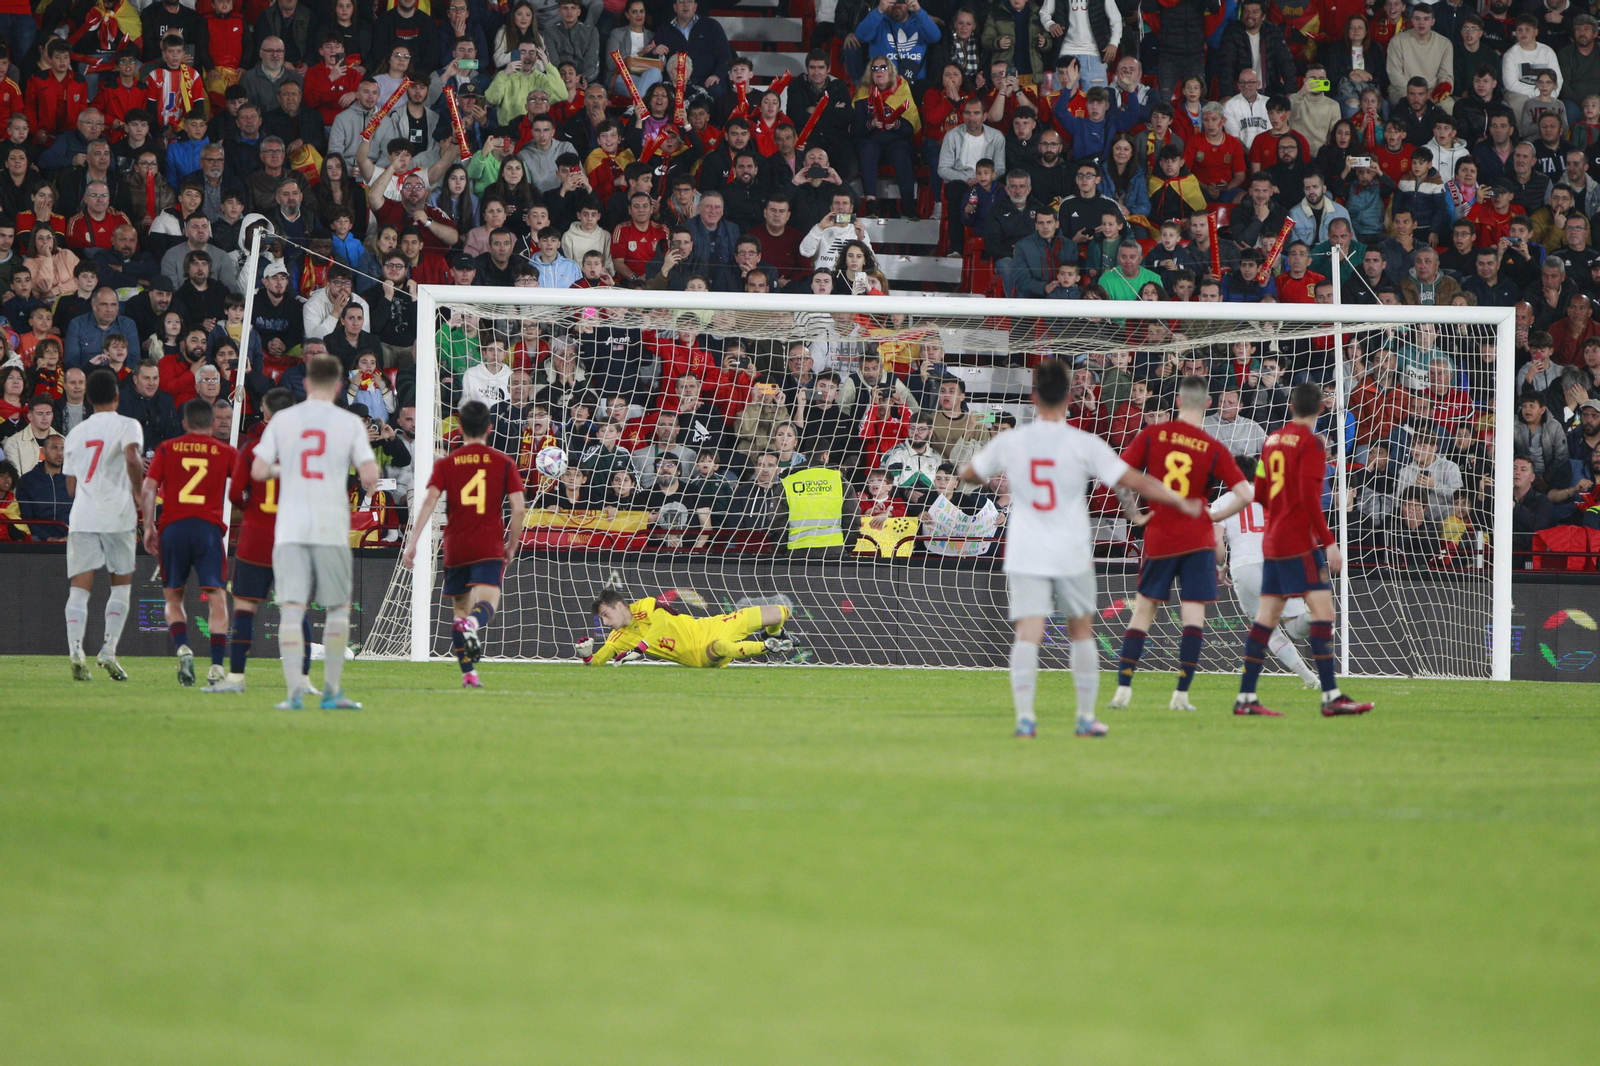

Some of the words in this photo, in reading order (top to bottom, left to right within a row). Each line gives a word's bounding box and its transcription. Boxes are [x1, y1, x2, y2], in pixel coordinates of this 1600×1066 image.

[886, 52, 922, 61] adidas
[85, 439, 105, 483] 7
[172, 441, 208, 453] VÍCTOR
[301, 429, 326, 480] 2
[454, 454, 480, 465] HUGO
[179, 457, 209, 505] 2
[460, 468, 487, 515] 4
[805, 479, 829, 487] grupo
[806, 485, 832, 493] control
[1030, 458, 1056, 511] 5
[1163, 450, 1193, 498] 8
[1269, 450, 1285, 500] 9
